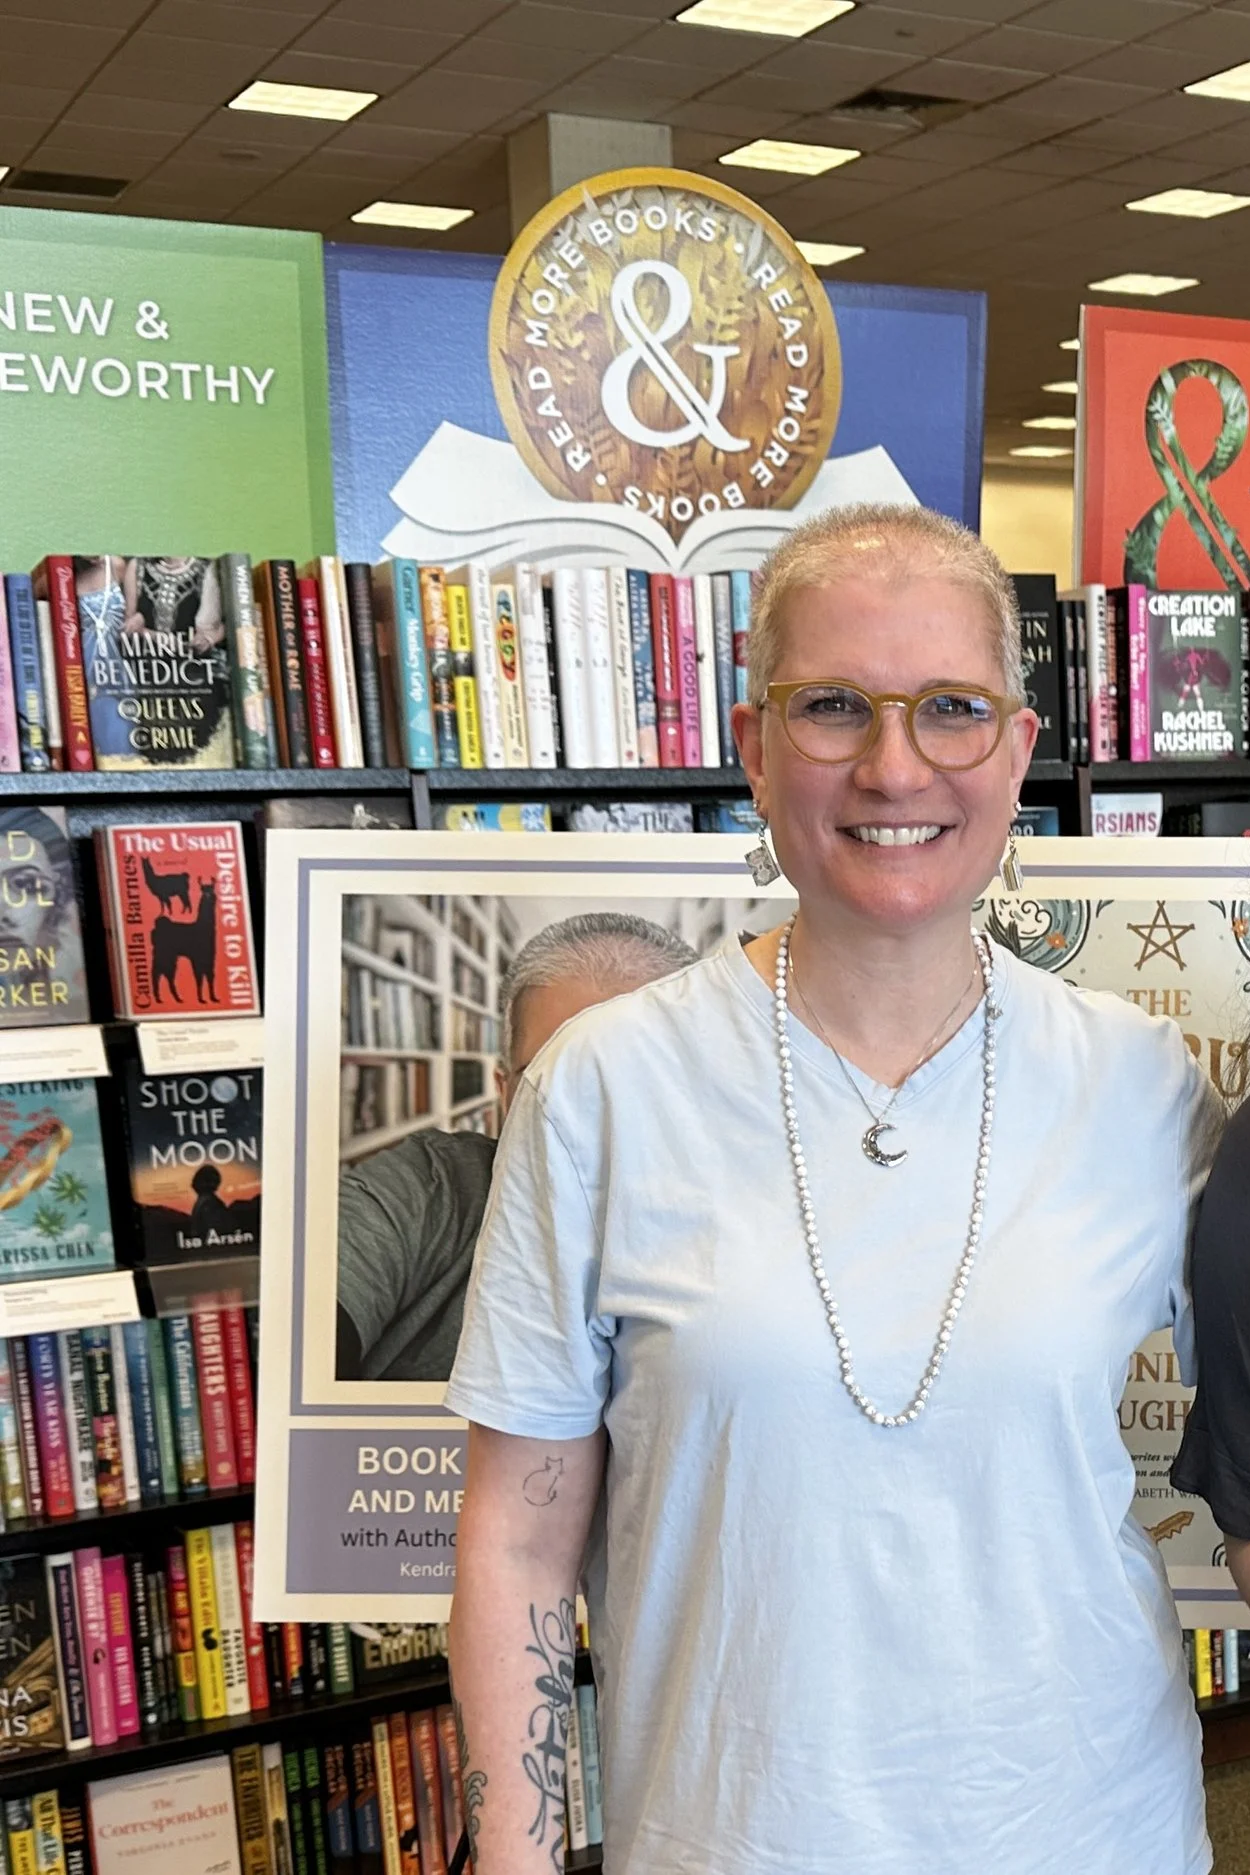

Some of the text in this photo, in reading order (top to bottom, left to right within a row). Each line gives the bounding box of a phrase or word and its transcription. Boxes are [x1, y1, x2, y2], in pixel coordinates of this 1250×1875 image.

[135, 300, 170, 341] &
[753, 262, 809, 369] READ
[525, 206, 718, 472] READ MORE BOOKS
[750, 385, 808, 488] MORE
[277, 565, 296, 630] MOTHER
[1148, 594, 1235, 617] CREATION
[1170, 616, 1217, 637] LAKE
[94, 659, 217, 685] BENEDICT
[409, 672, 425, 703] Grip
[683, 651, 696, 697] GOOD
[117, 697, 205, 724] QUEENS
[686, 702, 698, 732] LIFE
[1162, 710, 1226, 731] RACHEL
[1154, 731, 1234, 752] KUSHNER
[120, 830, 235, 853] The Usual
[121, 854, 152, 1009] Camilla Barnes
[215, 852, 251, 1004] Desire to Kill
[140, 1075, 254, 1108] SHOOT
[171, 1108, 228, 1136] THE
[150, 1137, 259, 1169] MOON
[177, 1229, 254, 1249] Isa Arsén
[172, 1318, 195, 1410] The Californians
[357, 1446, 462, 1475] BOOK
[348, 1489, 416, 1513] AND
[341, 1527, 389, 1548] with
[221, 1629, 234, 1689] DAUGHTER
[234, 1629, 246, 1685] FAVORITE
[97, 1800, 231, 1840] Correspondent
[151, 1798, 174, 1811] The
